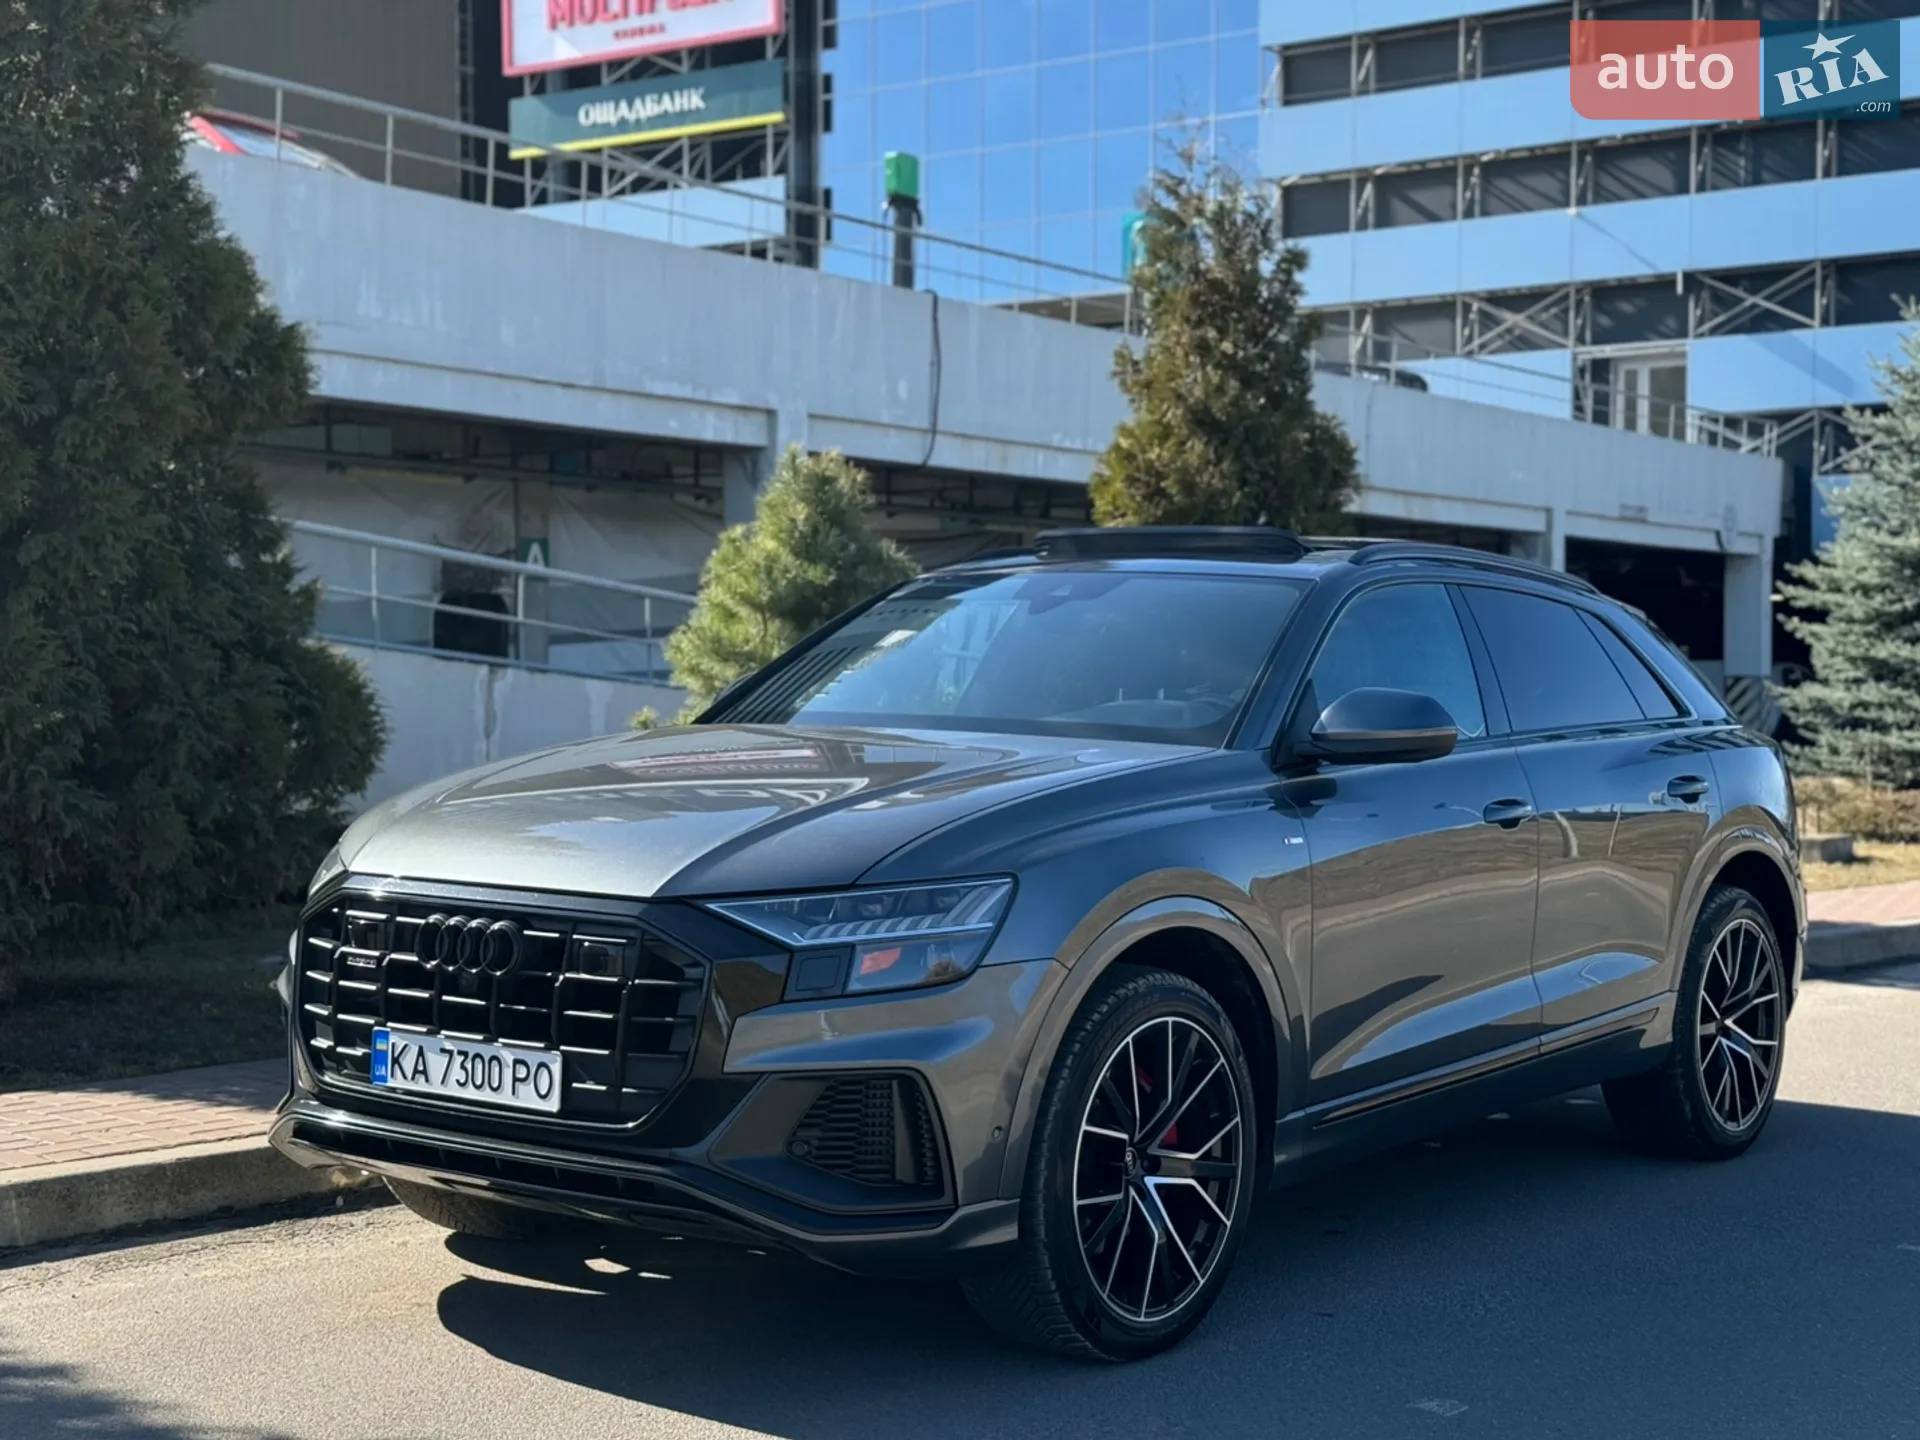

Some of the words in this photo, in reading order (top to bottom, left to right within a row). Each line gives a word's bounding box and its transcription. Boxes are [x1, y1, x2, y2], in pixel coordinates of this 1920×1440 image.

[577, 85, 707, 128] ОЩАДБАНК
[374, 1063, 387, 1076] UA
[390, 1041, 430, 1083] KA
[439, 1048, 502, 1092] 7300
[511, 1057, 553, 1100] PO
